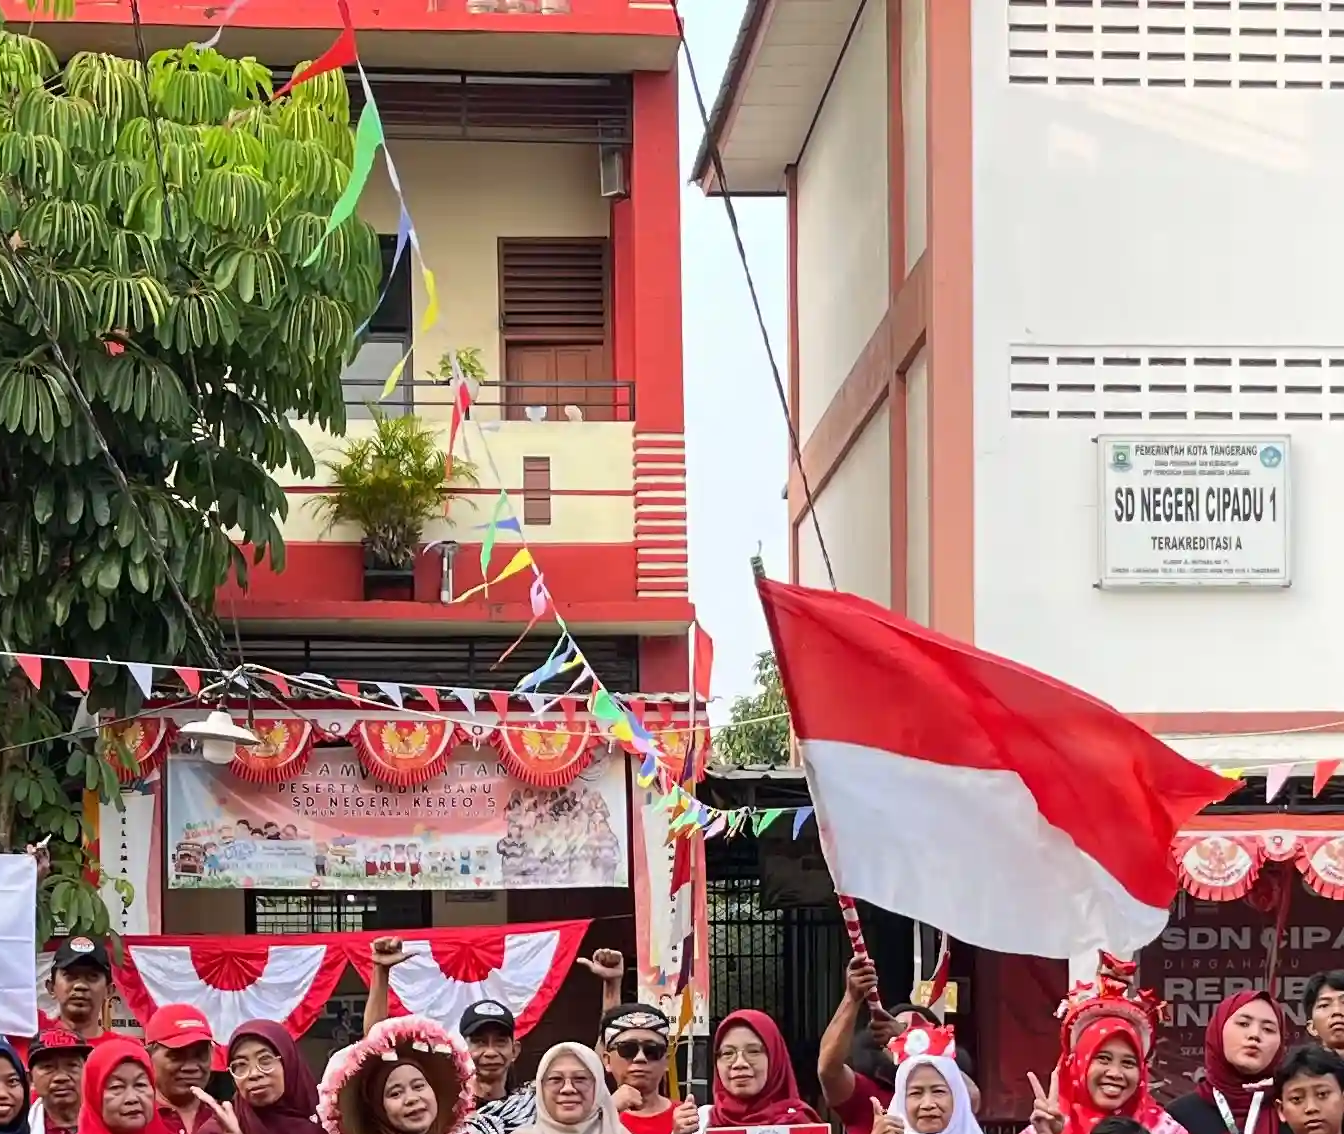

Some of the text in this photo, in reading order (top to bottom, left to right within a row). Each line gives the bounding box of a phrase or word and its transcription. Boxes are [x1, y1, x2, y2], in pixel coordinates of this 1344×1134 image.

[1135, 444, 1258, 457] PEMERINTAH KOTA TANGERANG
[1114, 486, 1277, 523] SD NEGERI CIPADU 1
[1151, 536, 1243, 551] TERAKREDITASI A
[278, 782, 360, 793] PESERTA
[444, 783, 492, 794] BARU
[292, 796, 315, 807] SD
[329, 797, 399, 807] NEGERI
[413, 797, 473, 807] KEREO
[1161, 926, 1251, 950] SDN
[1163, 958, 1300, 970] DIRGAHAYU
